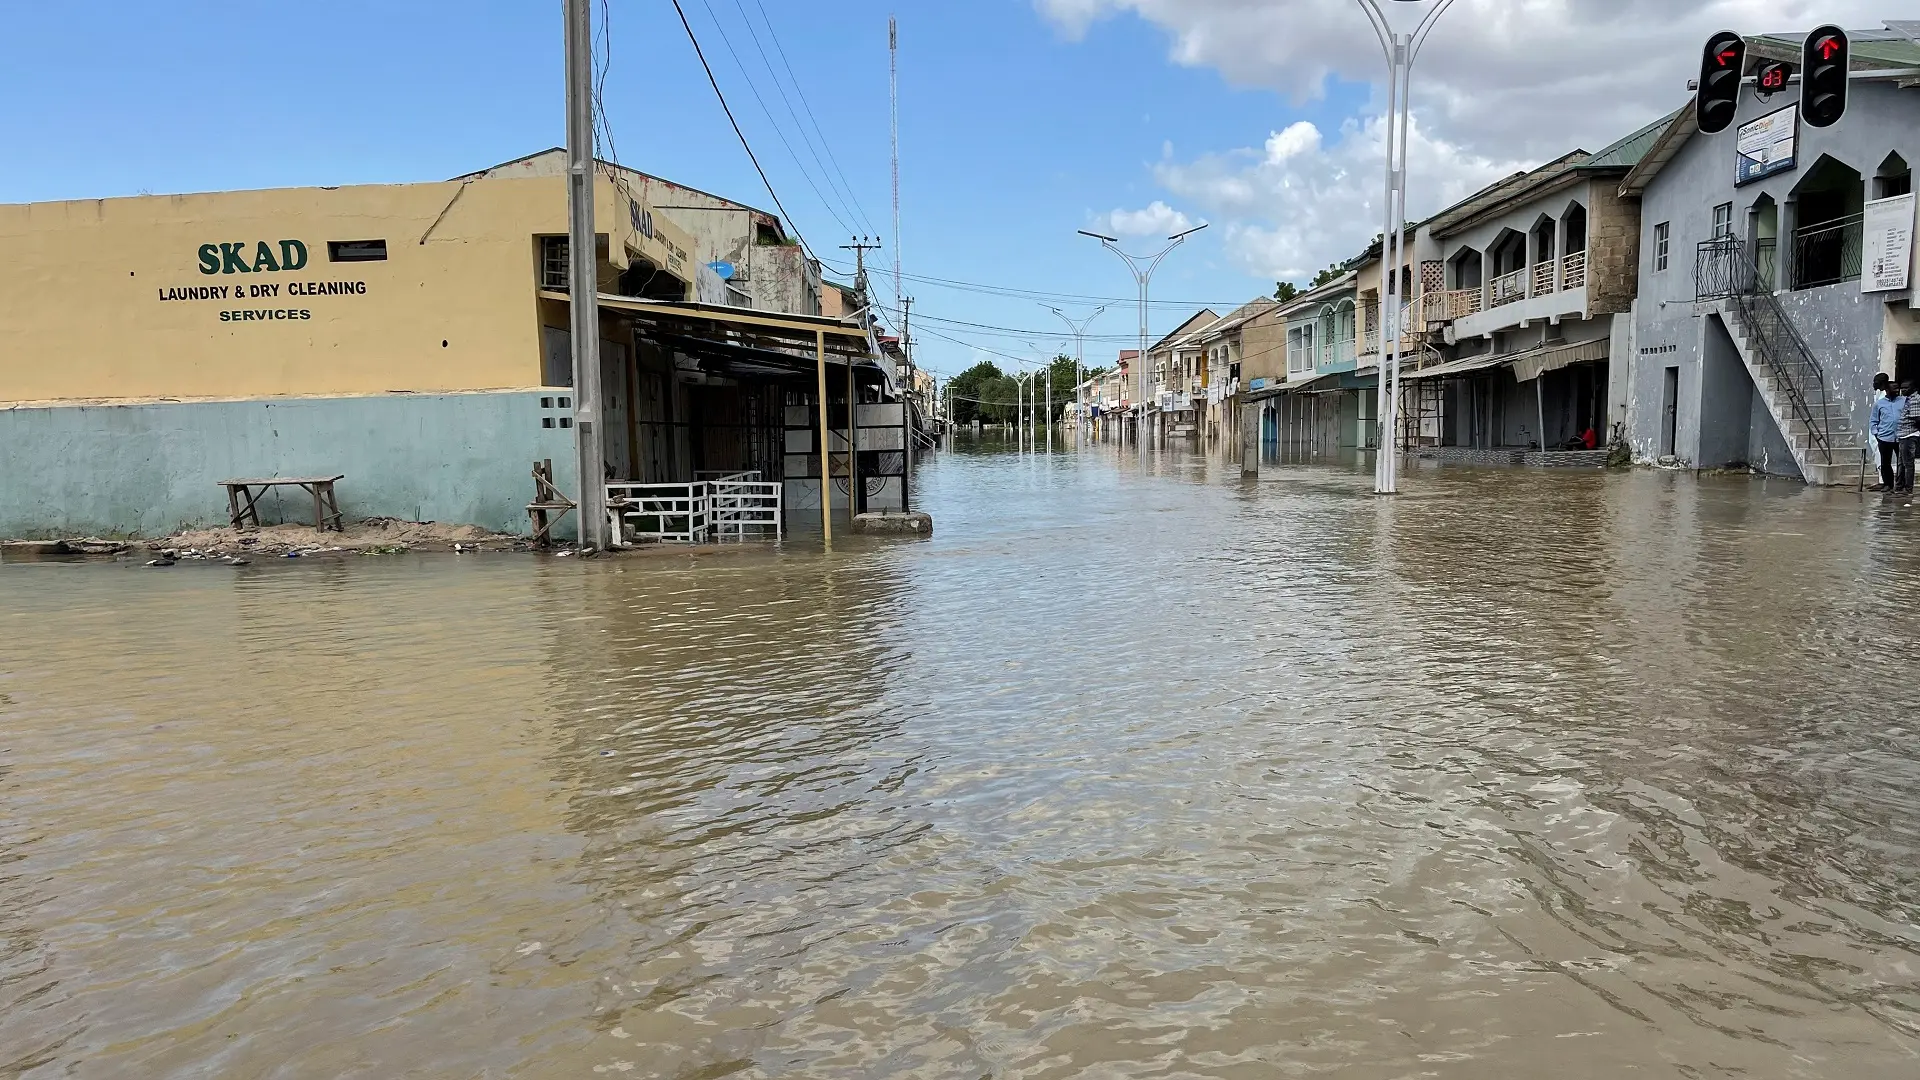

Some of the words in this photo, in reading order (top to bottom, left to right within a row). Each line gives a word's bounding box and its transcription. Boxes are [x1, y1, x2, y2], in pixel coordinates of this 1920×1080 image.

[630, 199, 653, 240] SKAD
[198, 239, 308, 275] SKAD
[158, 285, 229, 301] LAUNDRY
[234, 286, 246, 299] &
[250, 284, 280, 298] DRY
[288, 281, 367, 296] CLEANING
[219, 309, 311, 322] SERVICES
